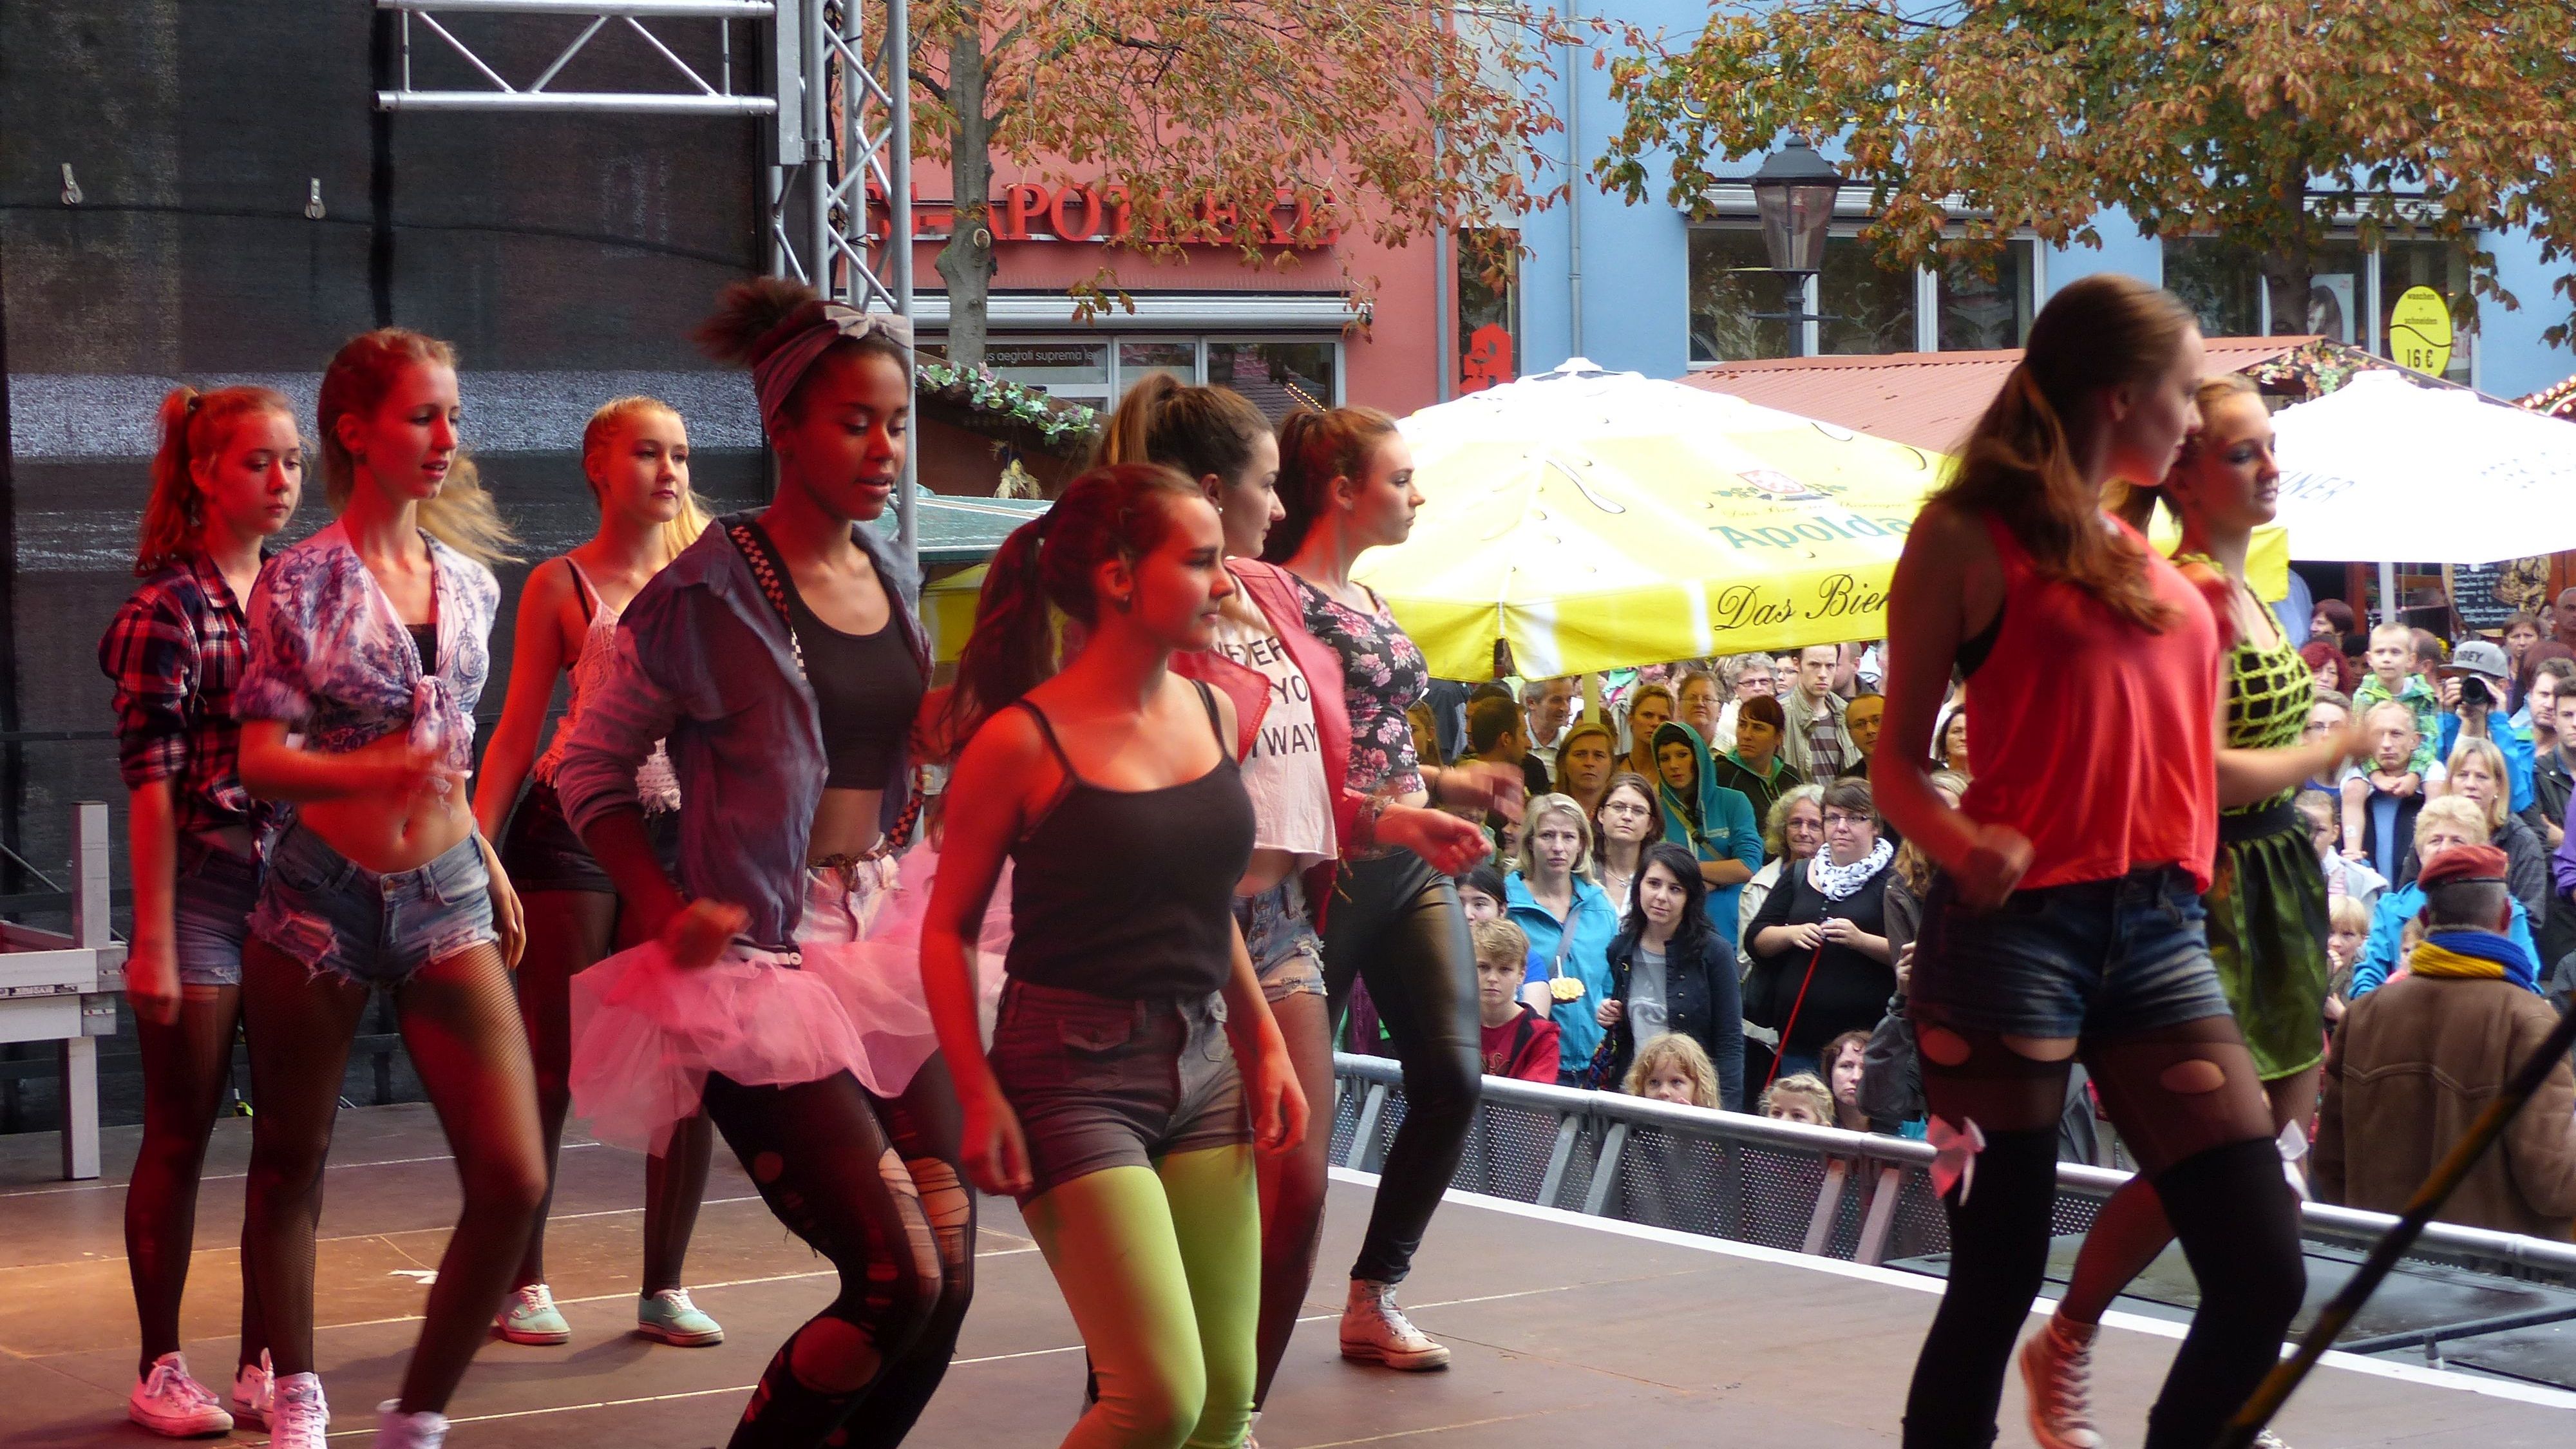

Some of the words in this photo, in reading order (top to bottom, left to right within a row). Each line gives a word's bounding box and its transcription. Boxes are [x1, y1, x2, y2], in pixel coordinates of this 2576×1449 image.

[1036, 352, 1082, 363] suprema
[2407, 349, 2421, 368] 16
[1714, 585, 1796, 631] Das
[1804, 573, 1889, 620] Bier
